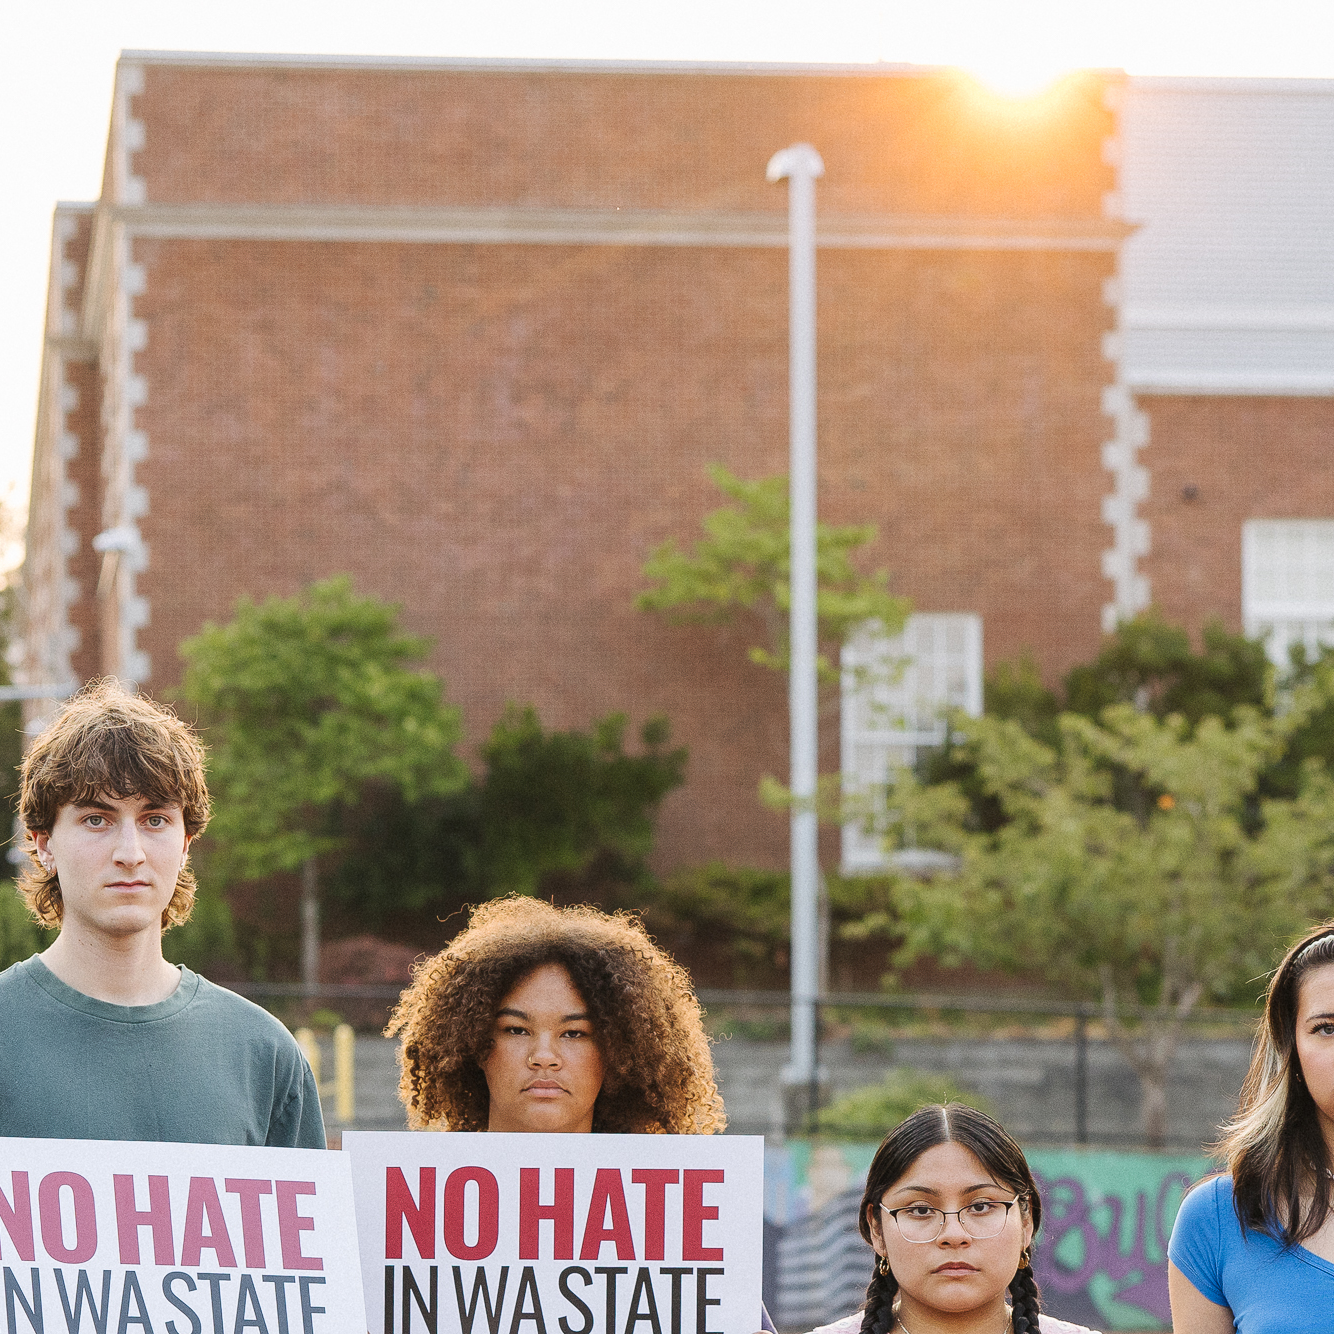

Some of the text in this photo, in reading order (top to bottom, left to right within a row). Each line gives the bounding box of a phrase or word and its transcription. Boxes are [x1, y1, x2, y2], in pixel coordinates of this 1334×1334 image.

[113, 1174, 324, 1271] HATE
[385, 1166, 724, 1261] NO HATE
